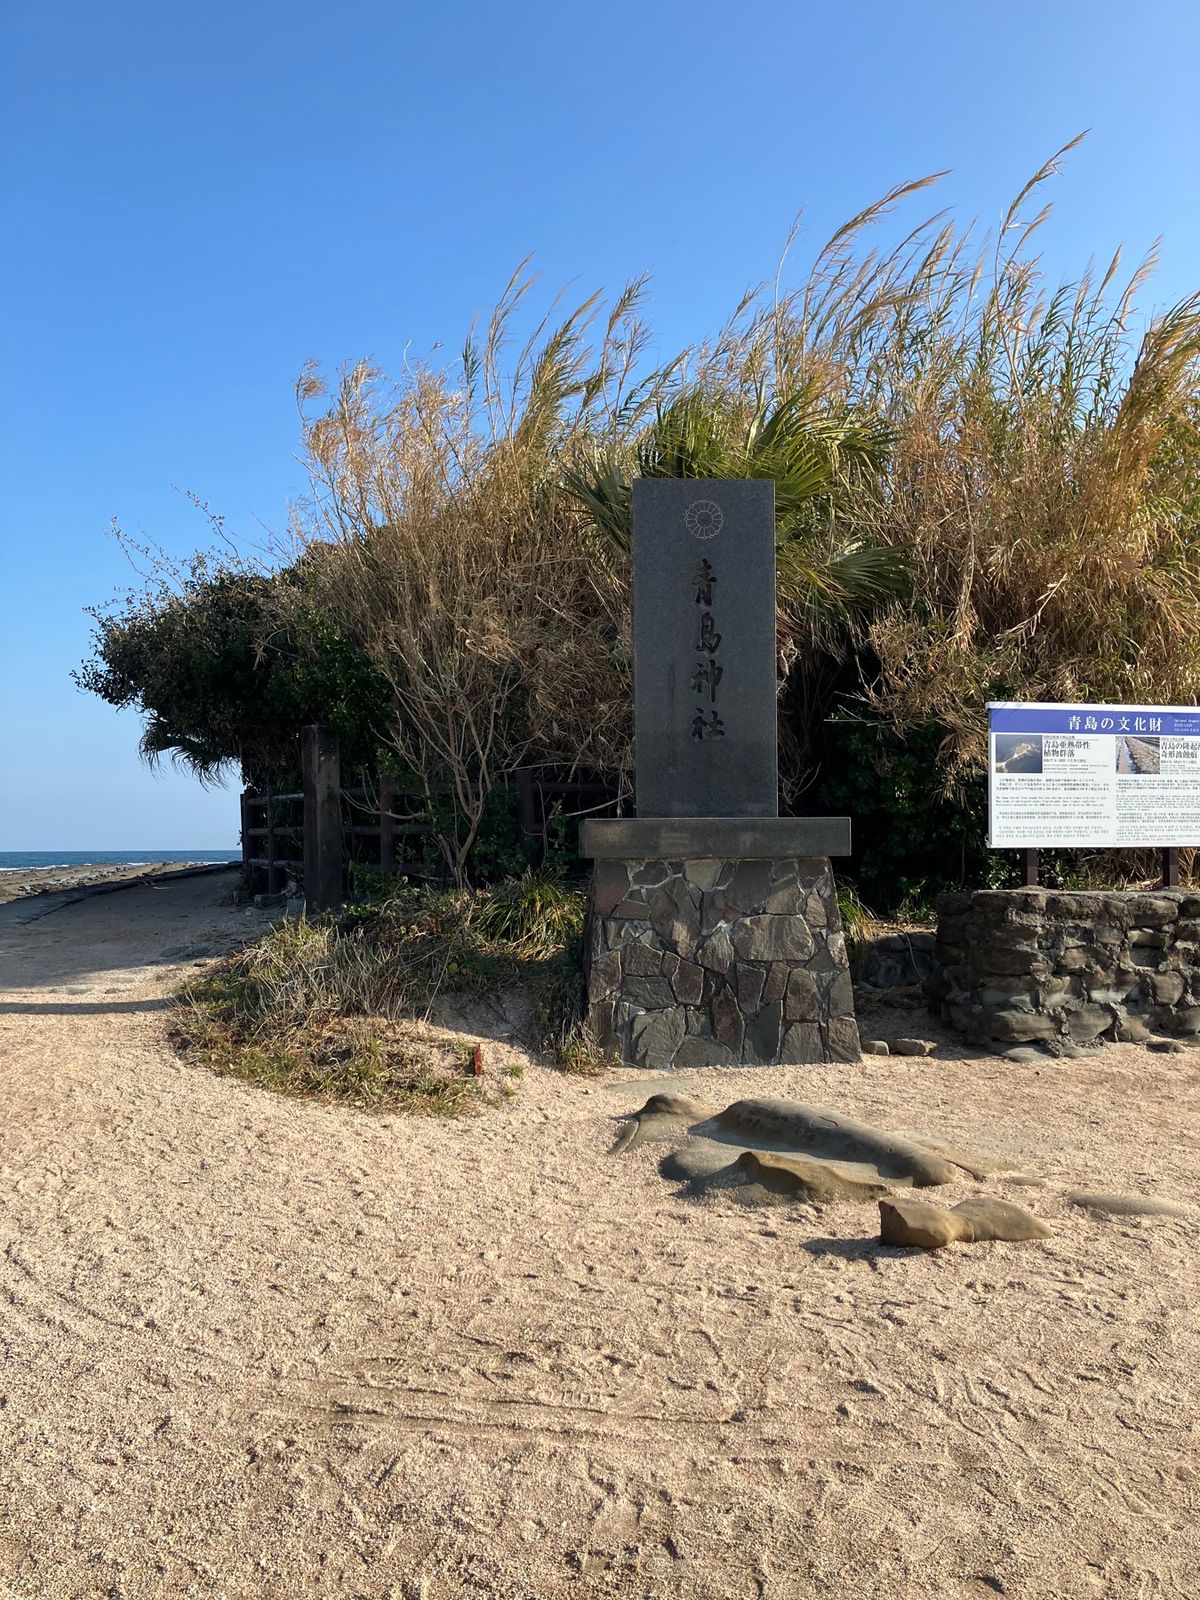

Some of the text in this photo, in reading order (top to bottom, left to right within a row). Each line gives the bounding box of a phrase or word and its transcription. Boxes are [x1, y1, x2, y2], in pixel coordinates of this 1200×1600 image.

[689, 557, 725, 740] 青島神社
[1067, 715, 1163, 732] 青島の文化財
